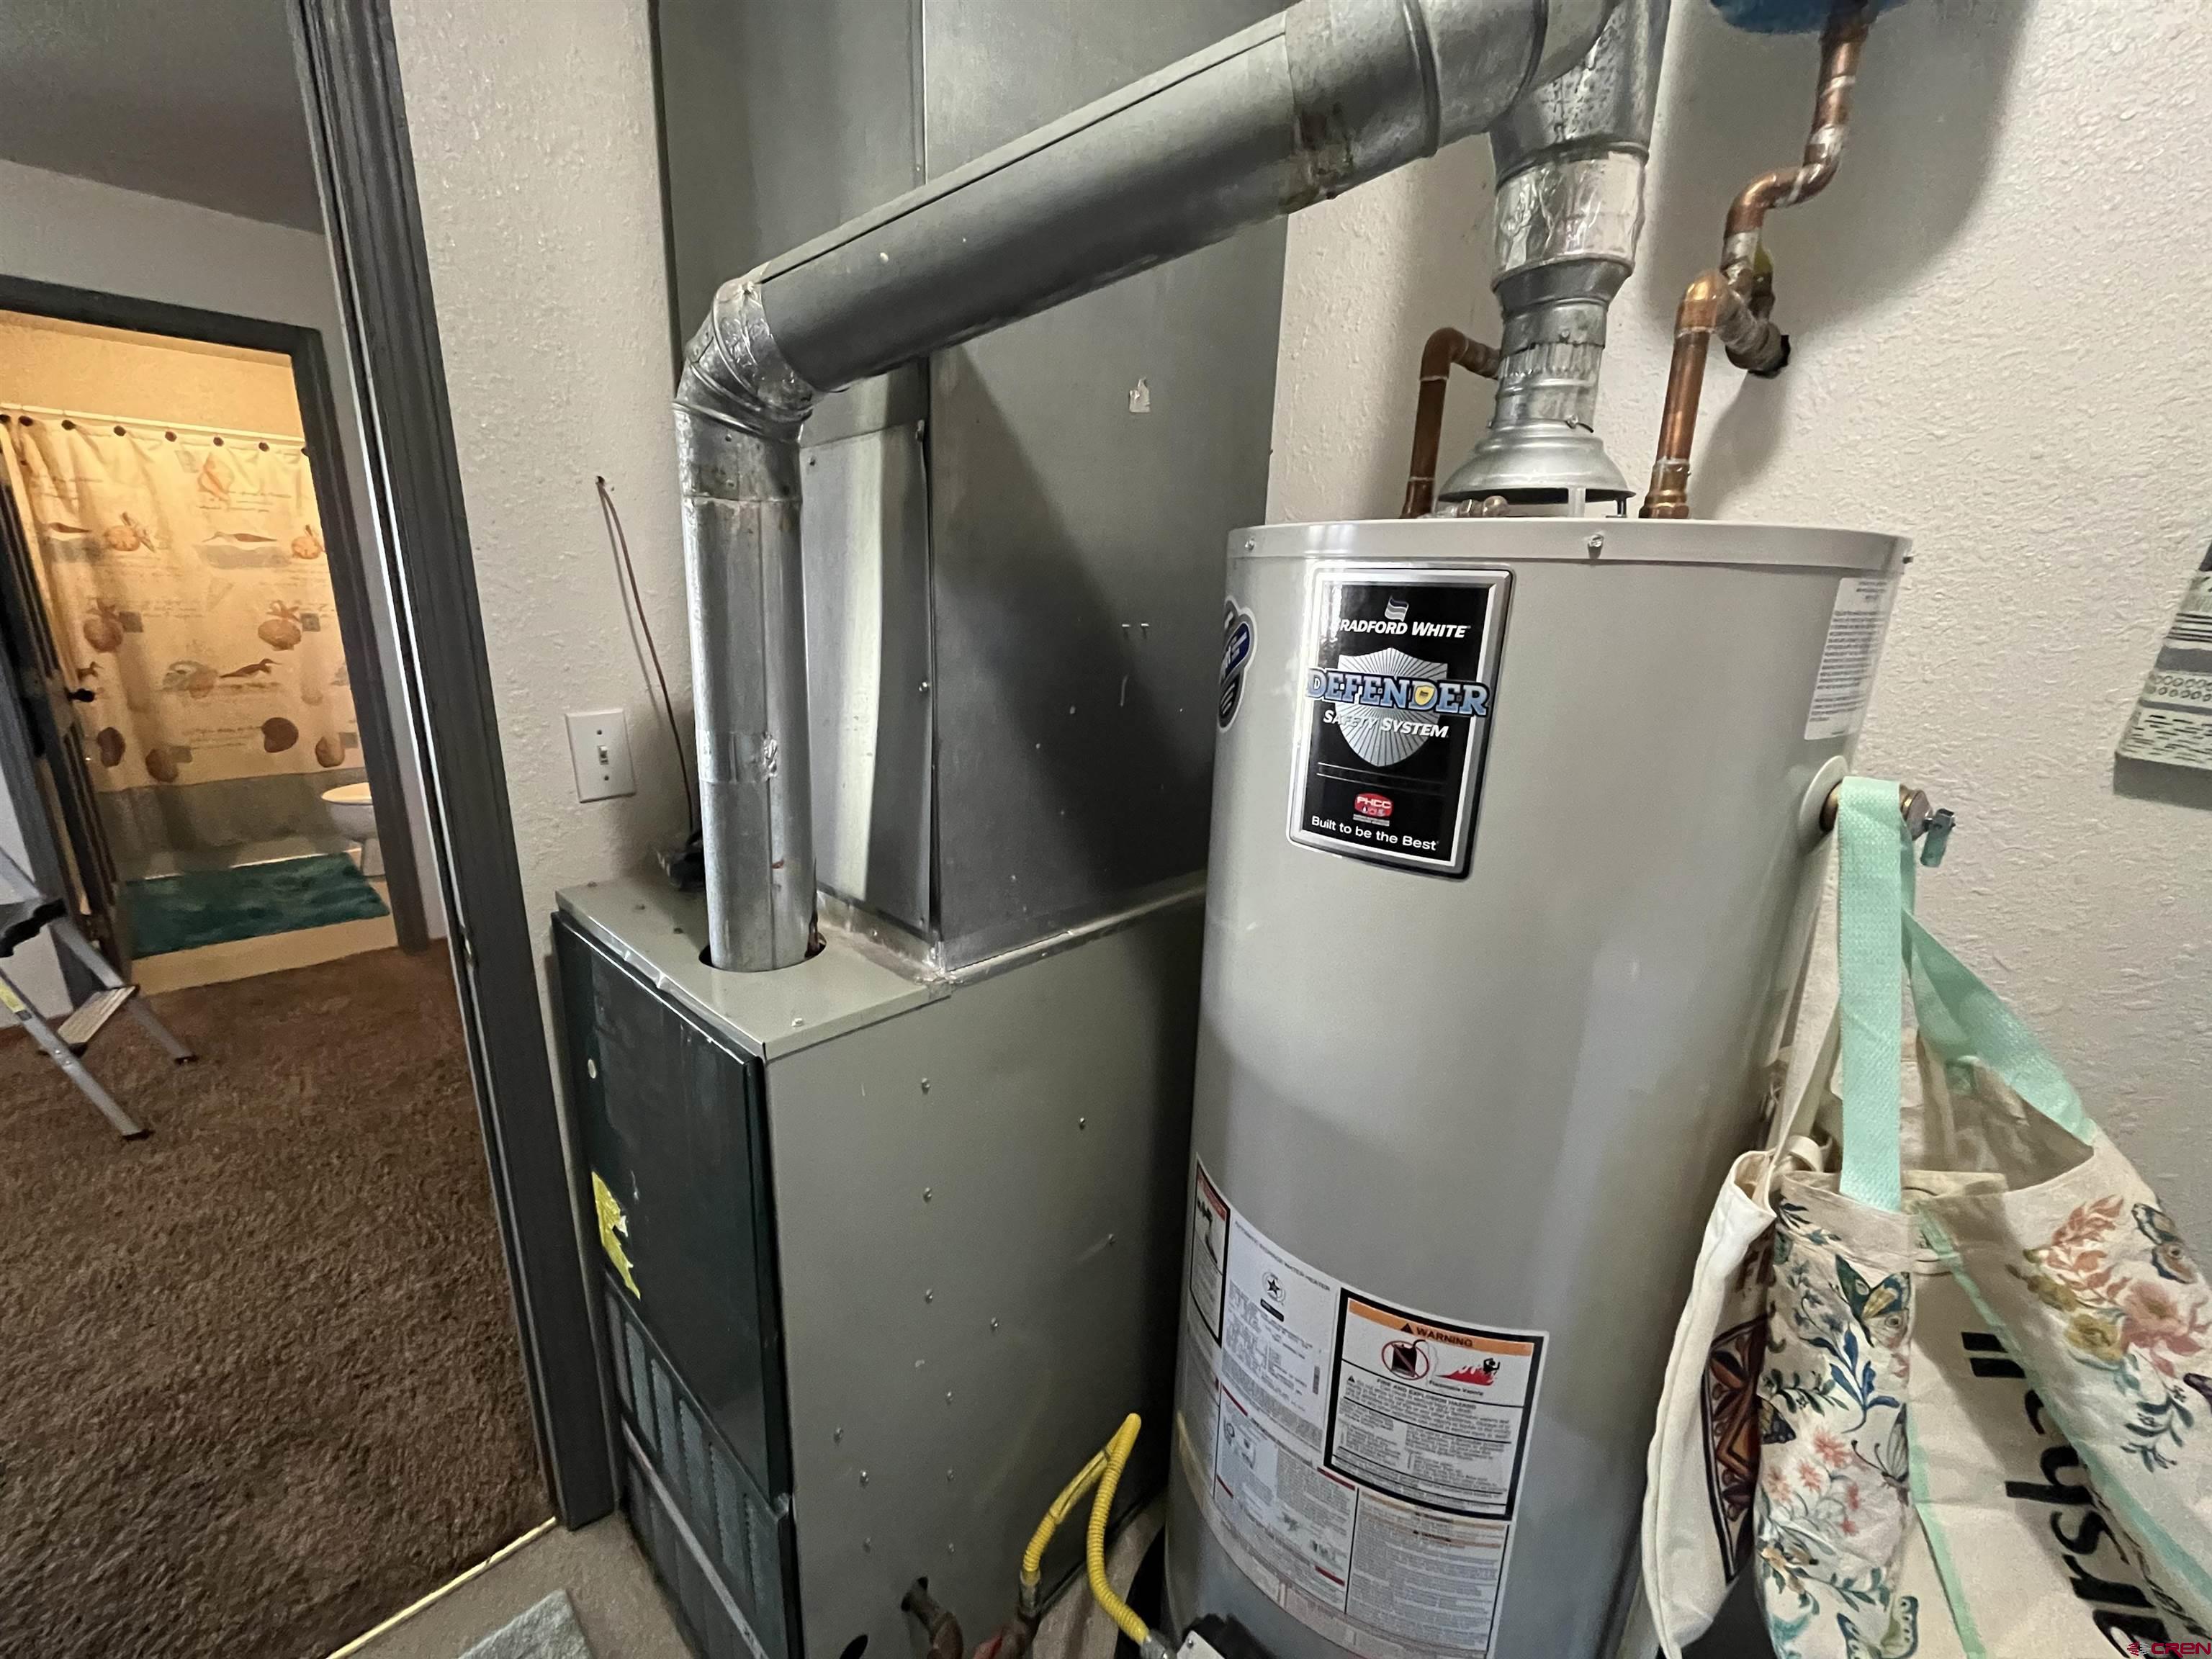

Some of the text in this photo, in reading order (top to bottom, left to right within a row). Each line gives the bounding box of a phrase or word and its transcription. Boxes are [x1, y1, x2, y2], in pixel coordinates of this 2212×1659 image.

[1331, 619, 1467, 639] RADFORD WHITE
[1307, 668, 1489, 716] DEFENDER
[1323, 710, 1449, 738] SAFETY SYSTEM
[1357, 796, 1393, 809] PHCC
[1311, 815, 1336, 831] Built
[1339, 822, 1352, 835] to
[1355, 826, 1372, 839] be
[1375, 830, 1398, 844] the
[1402, 835, 1437, 851] Best
[1416, 1326, 1474, 1348] WARNING
